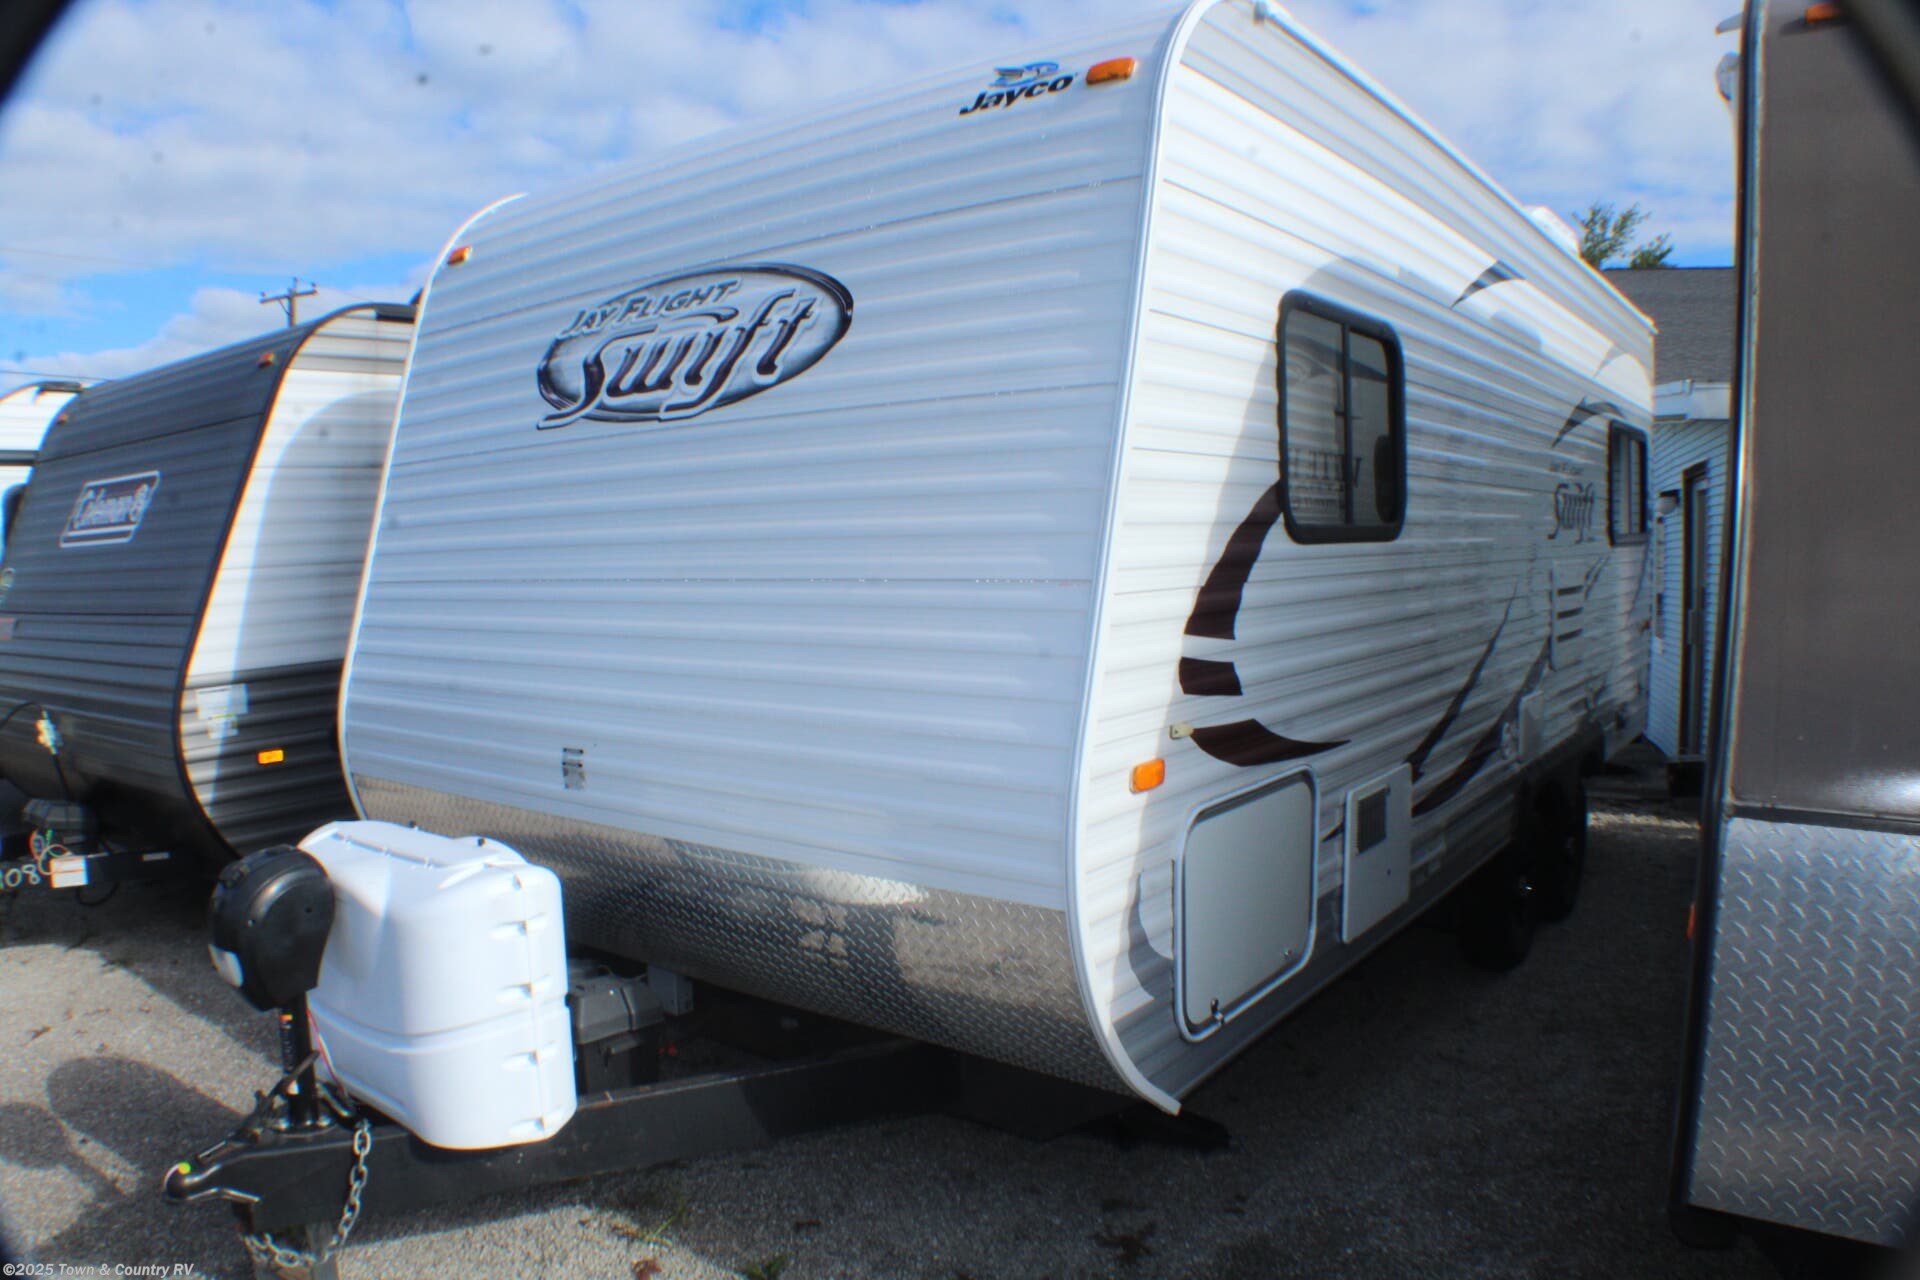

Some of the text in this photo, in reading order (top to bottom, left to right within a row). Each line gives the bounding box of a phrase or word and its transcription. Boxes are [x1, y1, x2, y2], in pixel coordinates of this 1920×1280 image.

[537, 289, 819, 430] Swift
[558, 280, 741, 339] JAY FLIGHT
